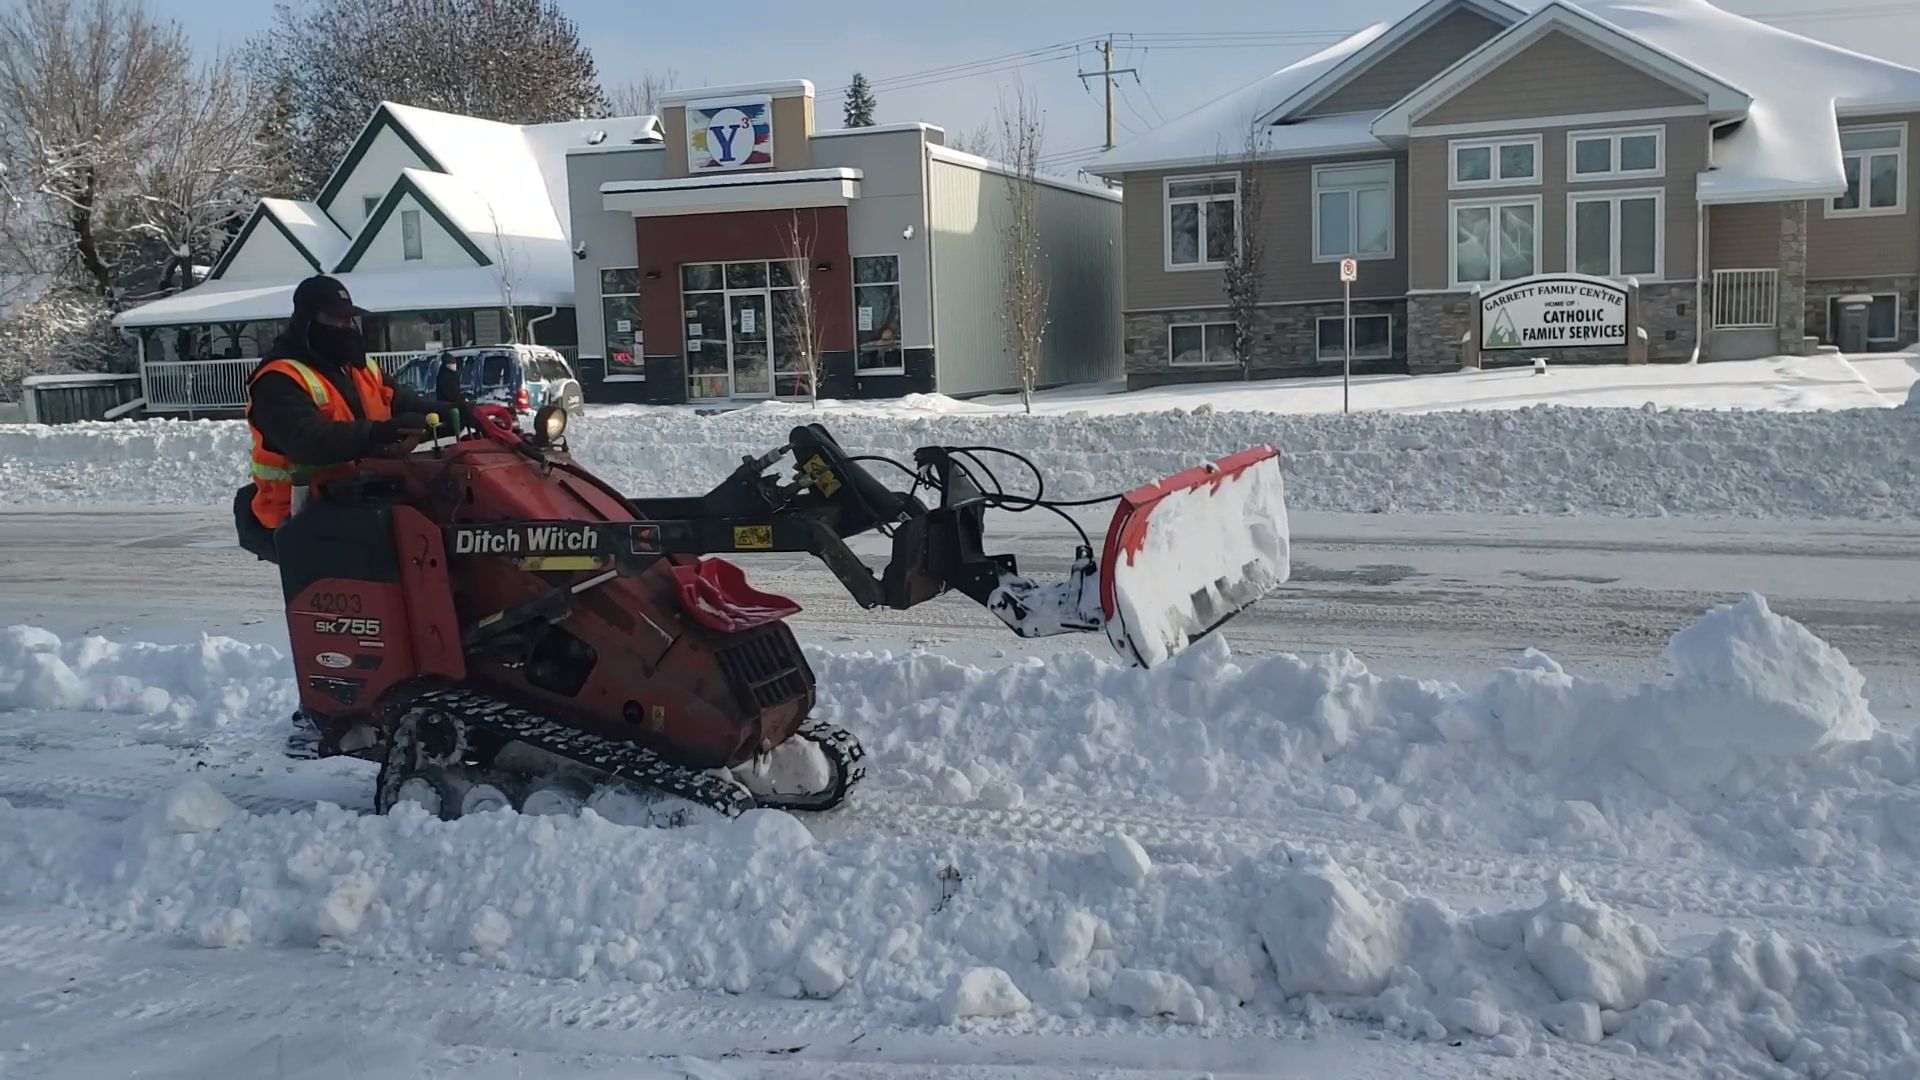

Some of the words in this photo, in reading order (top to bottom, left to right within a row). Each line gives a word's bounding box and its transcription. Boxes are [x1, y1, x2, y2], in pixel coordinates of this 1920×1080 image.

[1485, 287, 1535, 312] GARRETT
[1538, 285, 1577, 296] FAMILY
[1579, 287, 1624, 306] CENTRE
[1544, 300, 1564, 308] HOME
[1543, 308, 1604, 324] CATHOLIC
[1523, 326, 1565, 341] FAMILY
[1568, 324, 1625, 341] SERVICES
[456, 528, 520, 554] Ditch
[527, 525, 598, 552] Witch
[310, 592, 362, 613] 4203
